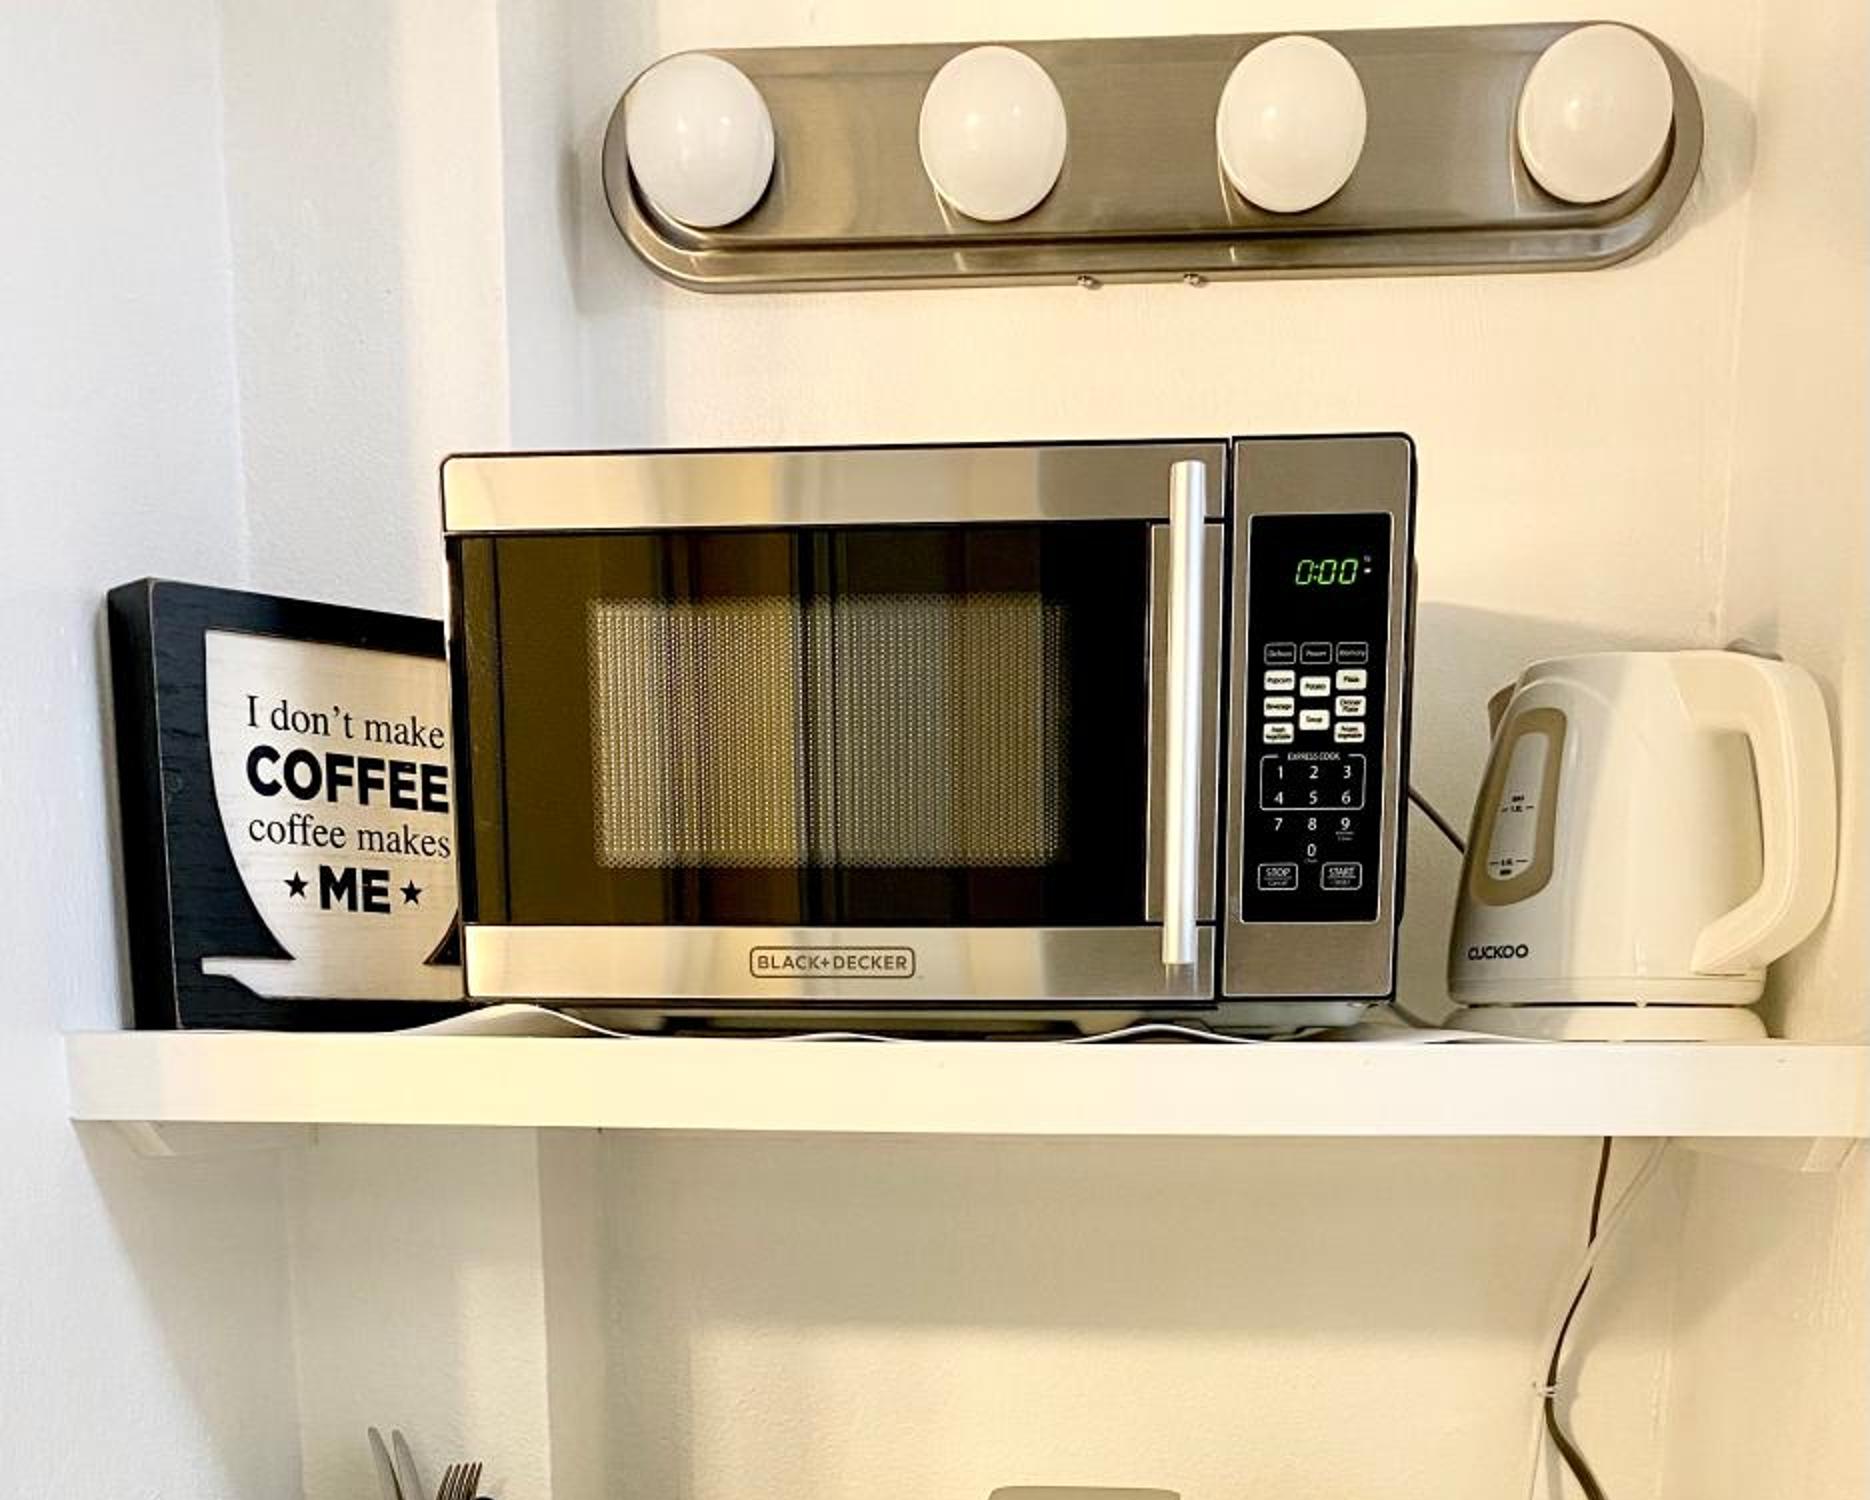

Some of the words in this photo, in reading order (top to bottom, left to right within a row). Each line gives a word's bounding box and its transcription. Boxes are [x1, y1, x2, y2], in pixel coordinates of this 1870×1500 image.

[1296, 559, 1358, 585] 0:00
[247, 695, 258, 728] I
[271, 699, 354, 739] don't
[365, 715, 446, 749] make
[247, 745, 449, 813] COFFEE
[1277, 765, 1283, 779] 1
[1308, 765, 1319, 779] 2
[1343, 765, 1352, 779] 3
[1273, 791, 1283, 805] 4
[1309, 790, 1318, 805] 5
[1341, 789, 1351, 805] 6
[1274, 817, 1283, 831] 7
[1307, 817, 1317, 831] 8
[1341, 817, 1351, 831] 9
[249, 813, 346, 849] coffee
[357, 824, 451, 858] makes
[1307, 843, 1317, 857] 0
[319, 865, 391, 913] ME
[1467, 944, 1529, 960] CUCKOO
[757, 955, 908, 970] BLACK+DECKER
